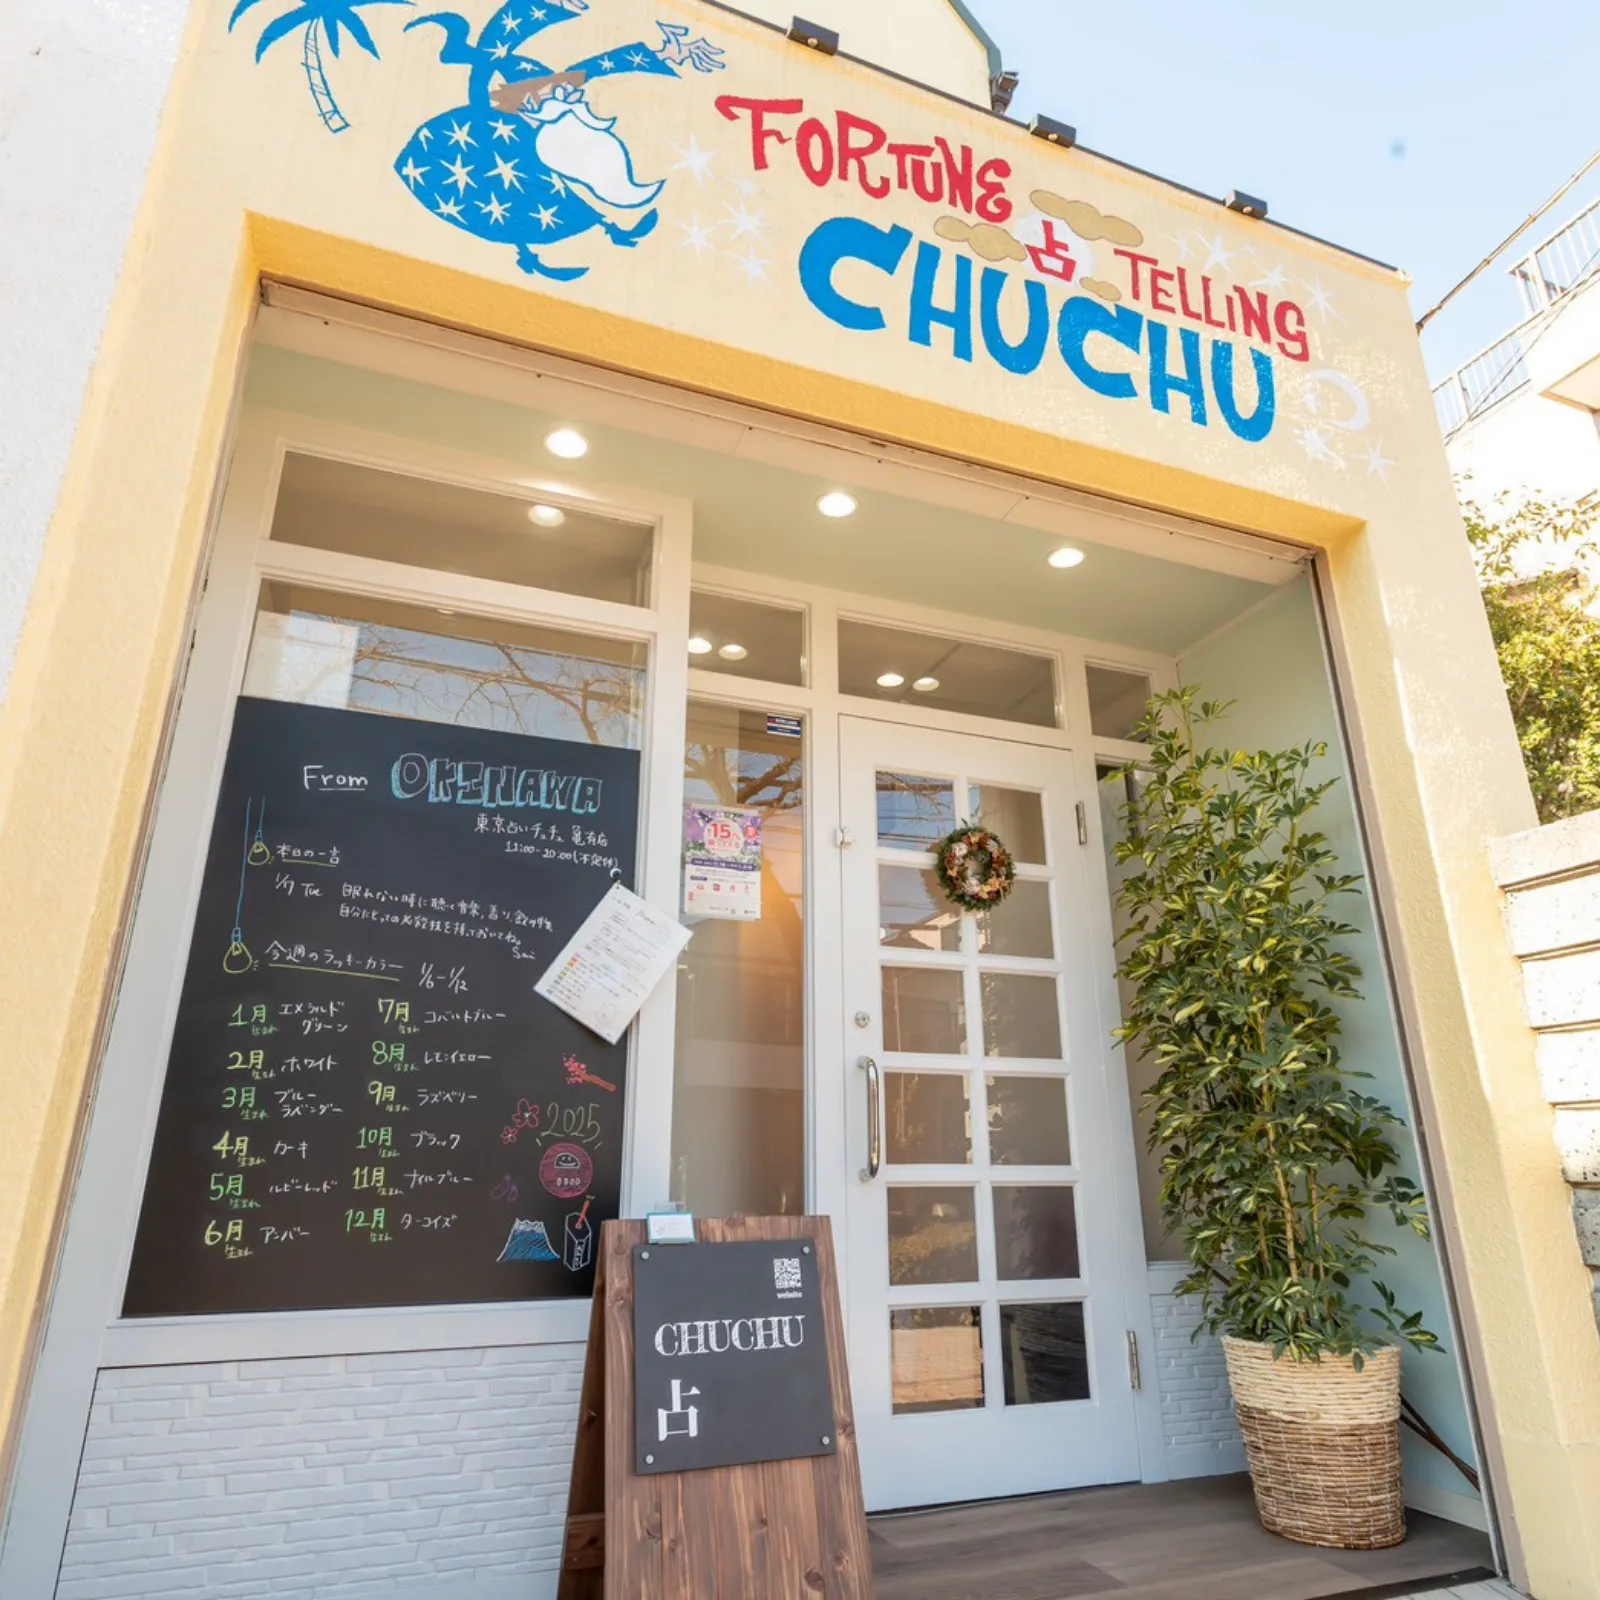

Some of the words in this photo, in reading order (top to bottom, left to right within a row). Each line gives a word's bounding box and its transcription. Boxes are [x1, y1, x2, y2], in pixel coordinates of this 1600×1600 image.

[715, 95, 1012, 222] FORTUNE
[1025, 219, 1076, 282] 占
[1114, 248, 1310, 361] TELLING
[798, 216, 1277, 442] CHUCHU
[303, 765, 368, 789] From
[391, 752, 603, 814] OKINAWA
[301, 882, 324, 897] Tue
[265, 940, 404, 969] 今週のラッキーカラー
[228, 1003, 266, 1027] 1月
[377, 997, 410, 1024] 7月
[227, 1049, 264, 1070] 2月
[371, 1040, 405, 1065] 8月
[221, 1086, 256, 1108] 3月
[368, 1080, 396, 1106] 9月
[540, 1101, 601, 1143] 2025
[212, 1130, 249, 1159] 4月
[356, 1126, 393, 1149] 10月
[209, 1172, 243, 1200] 5月
[352, 1166, 386, 1190] 11月
[204, 1219, 243, 1245] 6月
[345, 1207, 386, 1233] 12月
[654, 1315, 806, 1356] CHUCHU
[657, 1379, 701, 1442] 占
